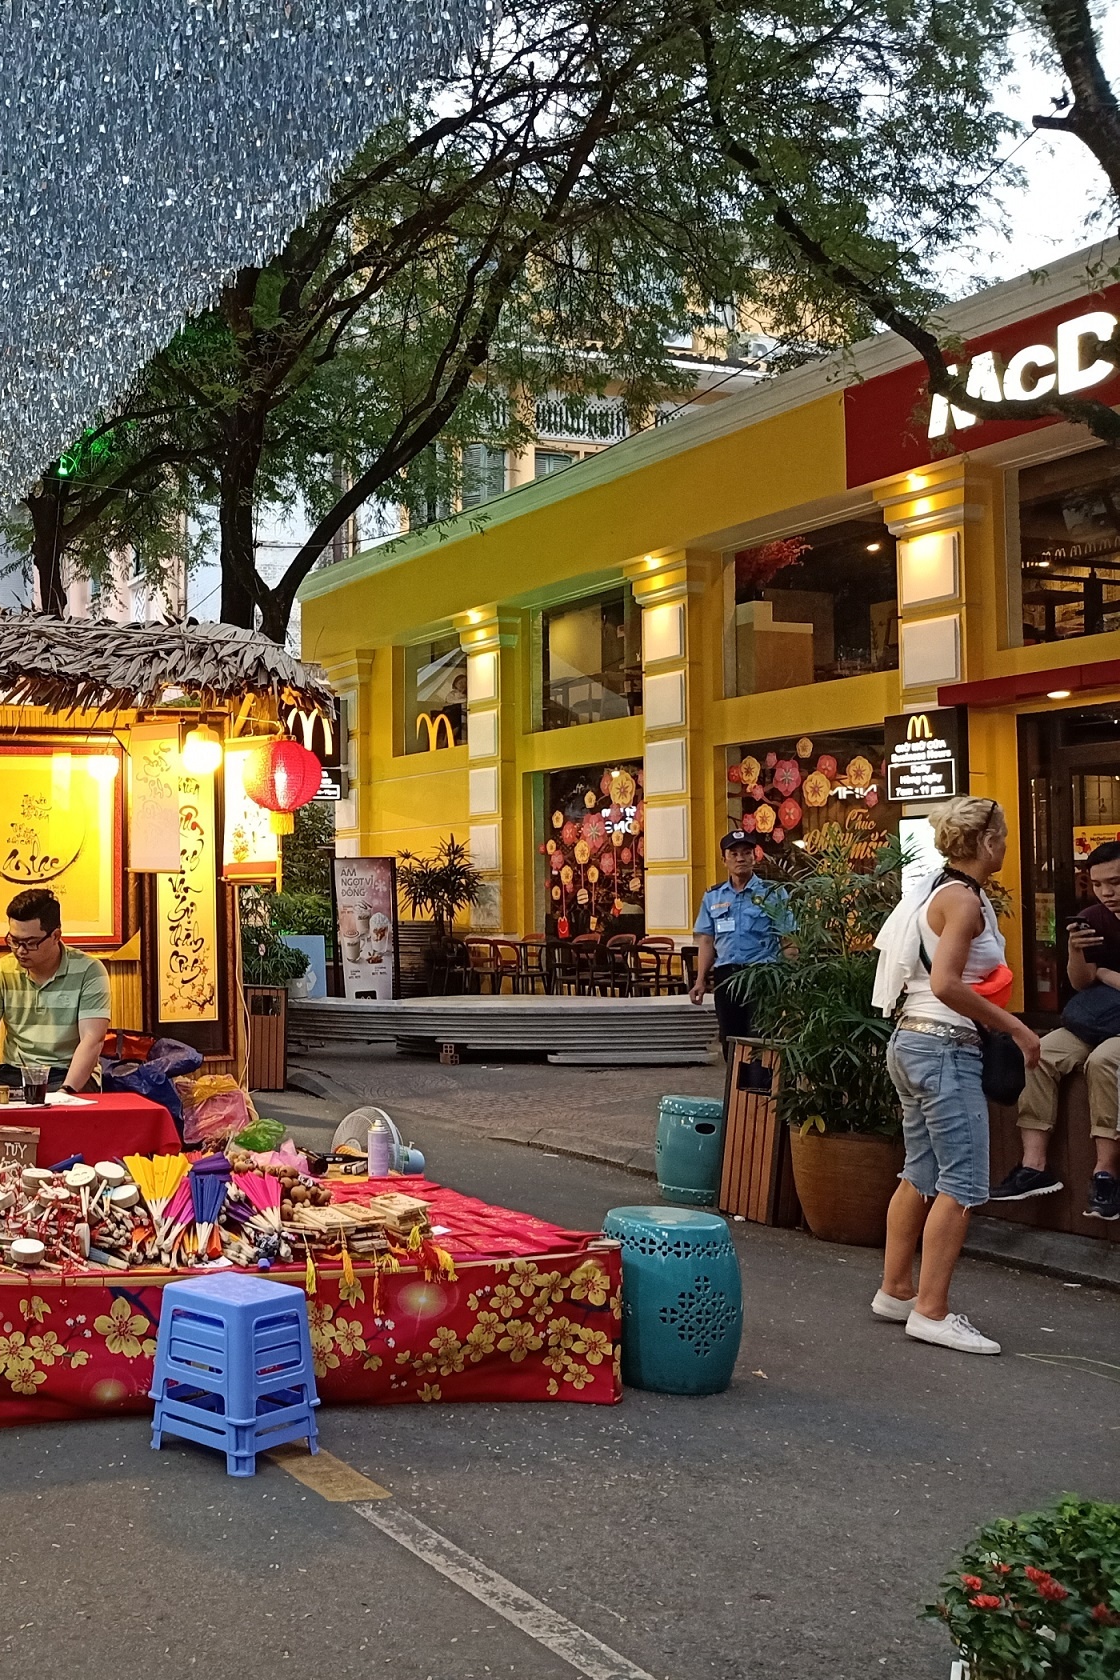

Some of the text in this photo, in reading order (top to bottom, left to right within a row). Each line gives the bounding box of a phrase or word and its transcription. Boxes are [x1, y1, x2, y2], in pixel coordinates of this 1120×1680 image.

[891, 749, 952, 763] Business Hours
[910, 764, 931, 774] Daily
[920, 785, 930, 795] 11
[930, 785, 946, 796] pm
